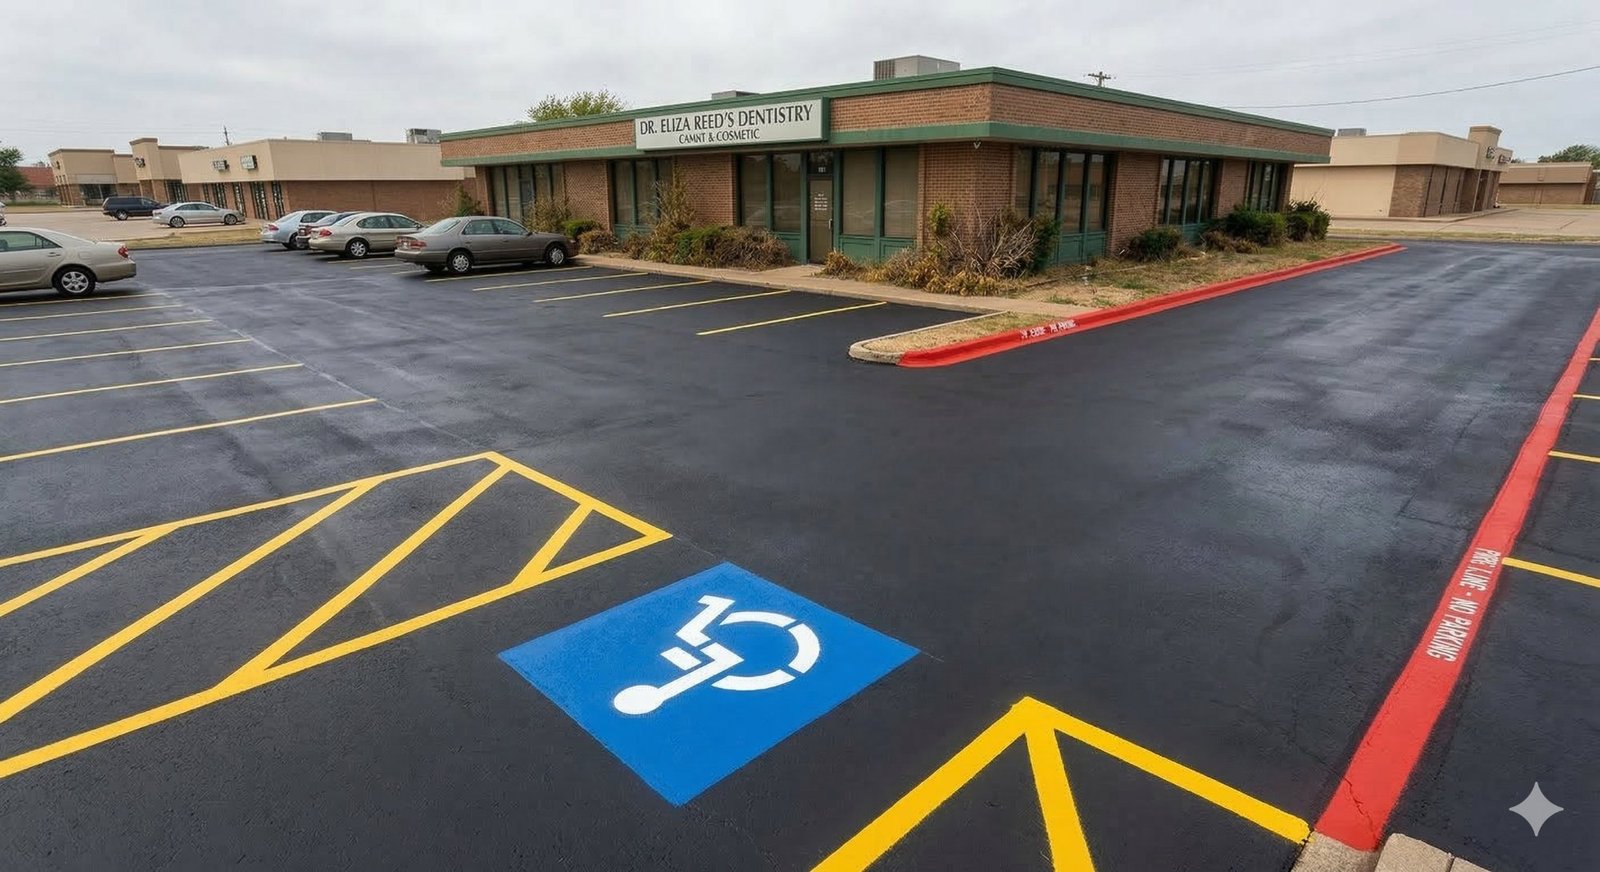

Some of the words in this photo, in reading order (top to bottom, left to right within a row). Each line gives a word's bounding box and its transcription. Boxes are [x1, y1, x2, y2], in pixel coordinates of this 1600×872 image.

[640, 120, 657, 135] DR.
[660, 117, 691, 133] ELIZA
[694, 112, 734, 130] REED'S
[738, 104, 812, 126] DENTISTRY
[708, 132, 715, 143] &
[716, 128, 760, 142] COSMETIC
[1448, 597, 1479, 614] NO
[1427, 614, 1472, 661] PARKING
